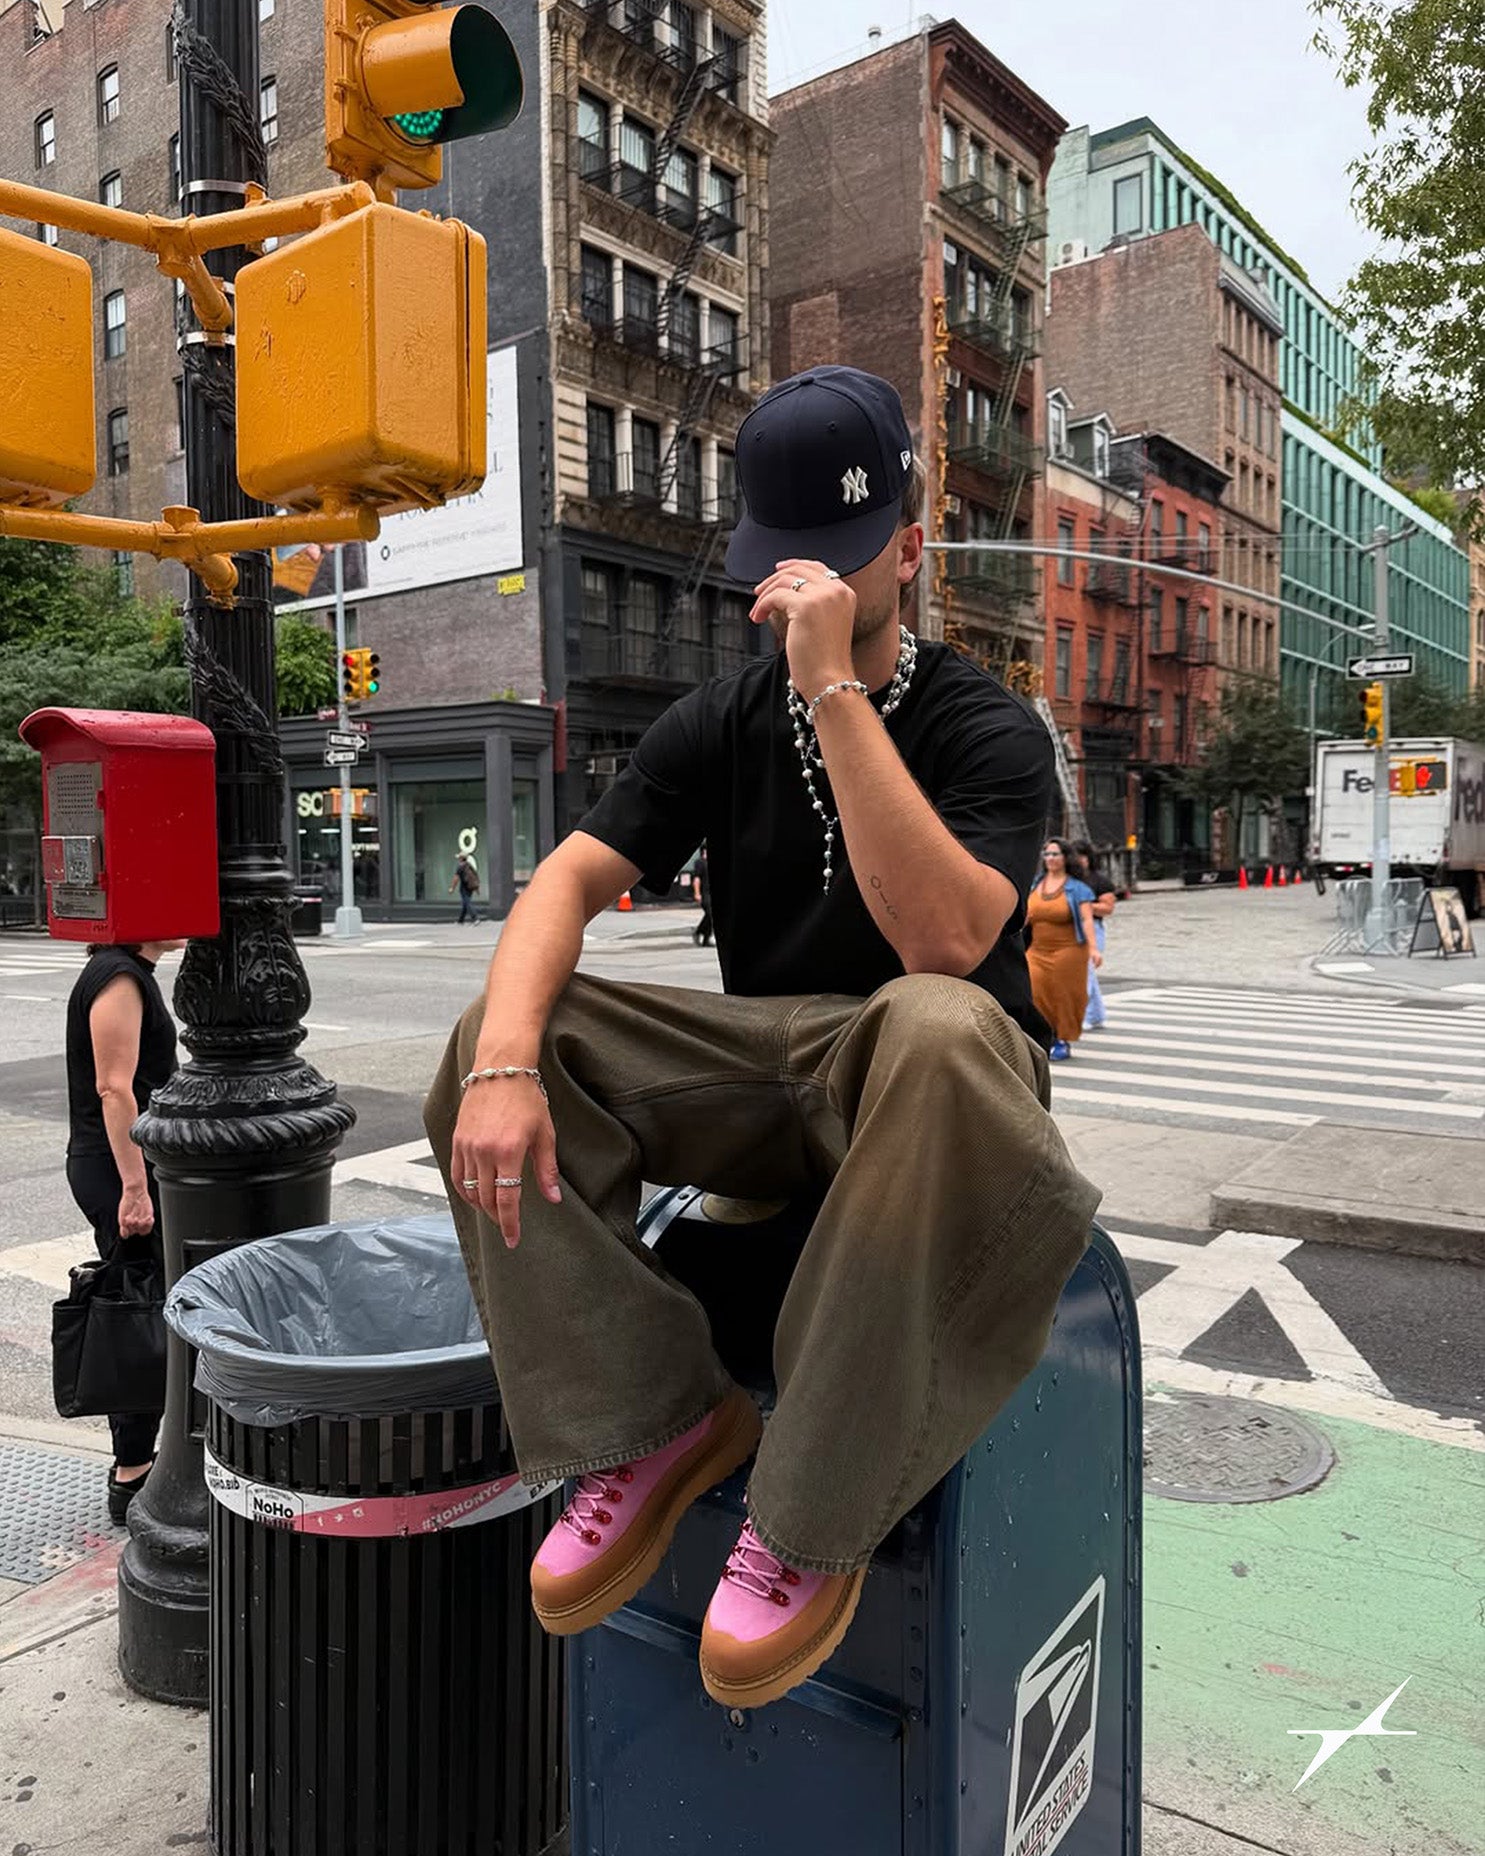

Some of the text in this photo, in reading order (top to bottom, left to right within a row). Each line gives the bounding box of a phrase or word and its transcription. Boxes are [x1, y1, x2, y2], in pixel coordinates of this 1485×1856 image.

[841, 466, 869, 504] NY
[253, 1497, 294, 1519] NoHo
[1049, 1767, 1089, 1842] SERVICE
[1051, 1749, 1086, 1814] STATES
